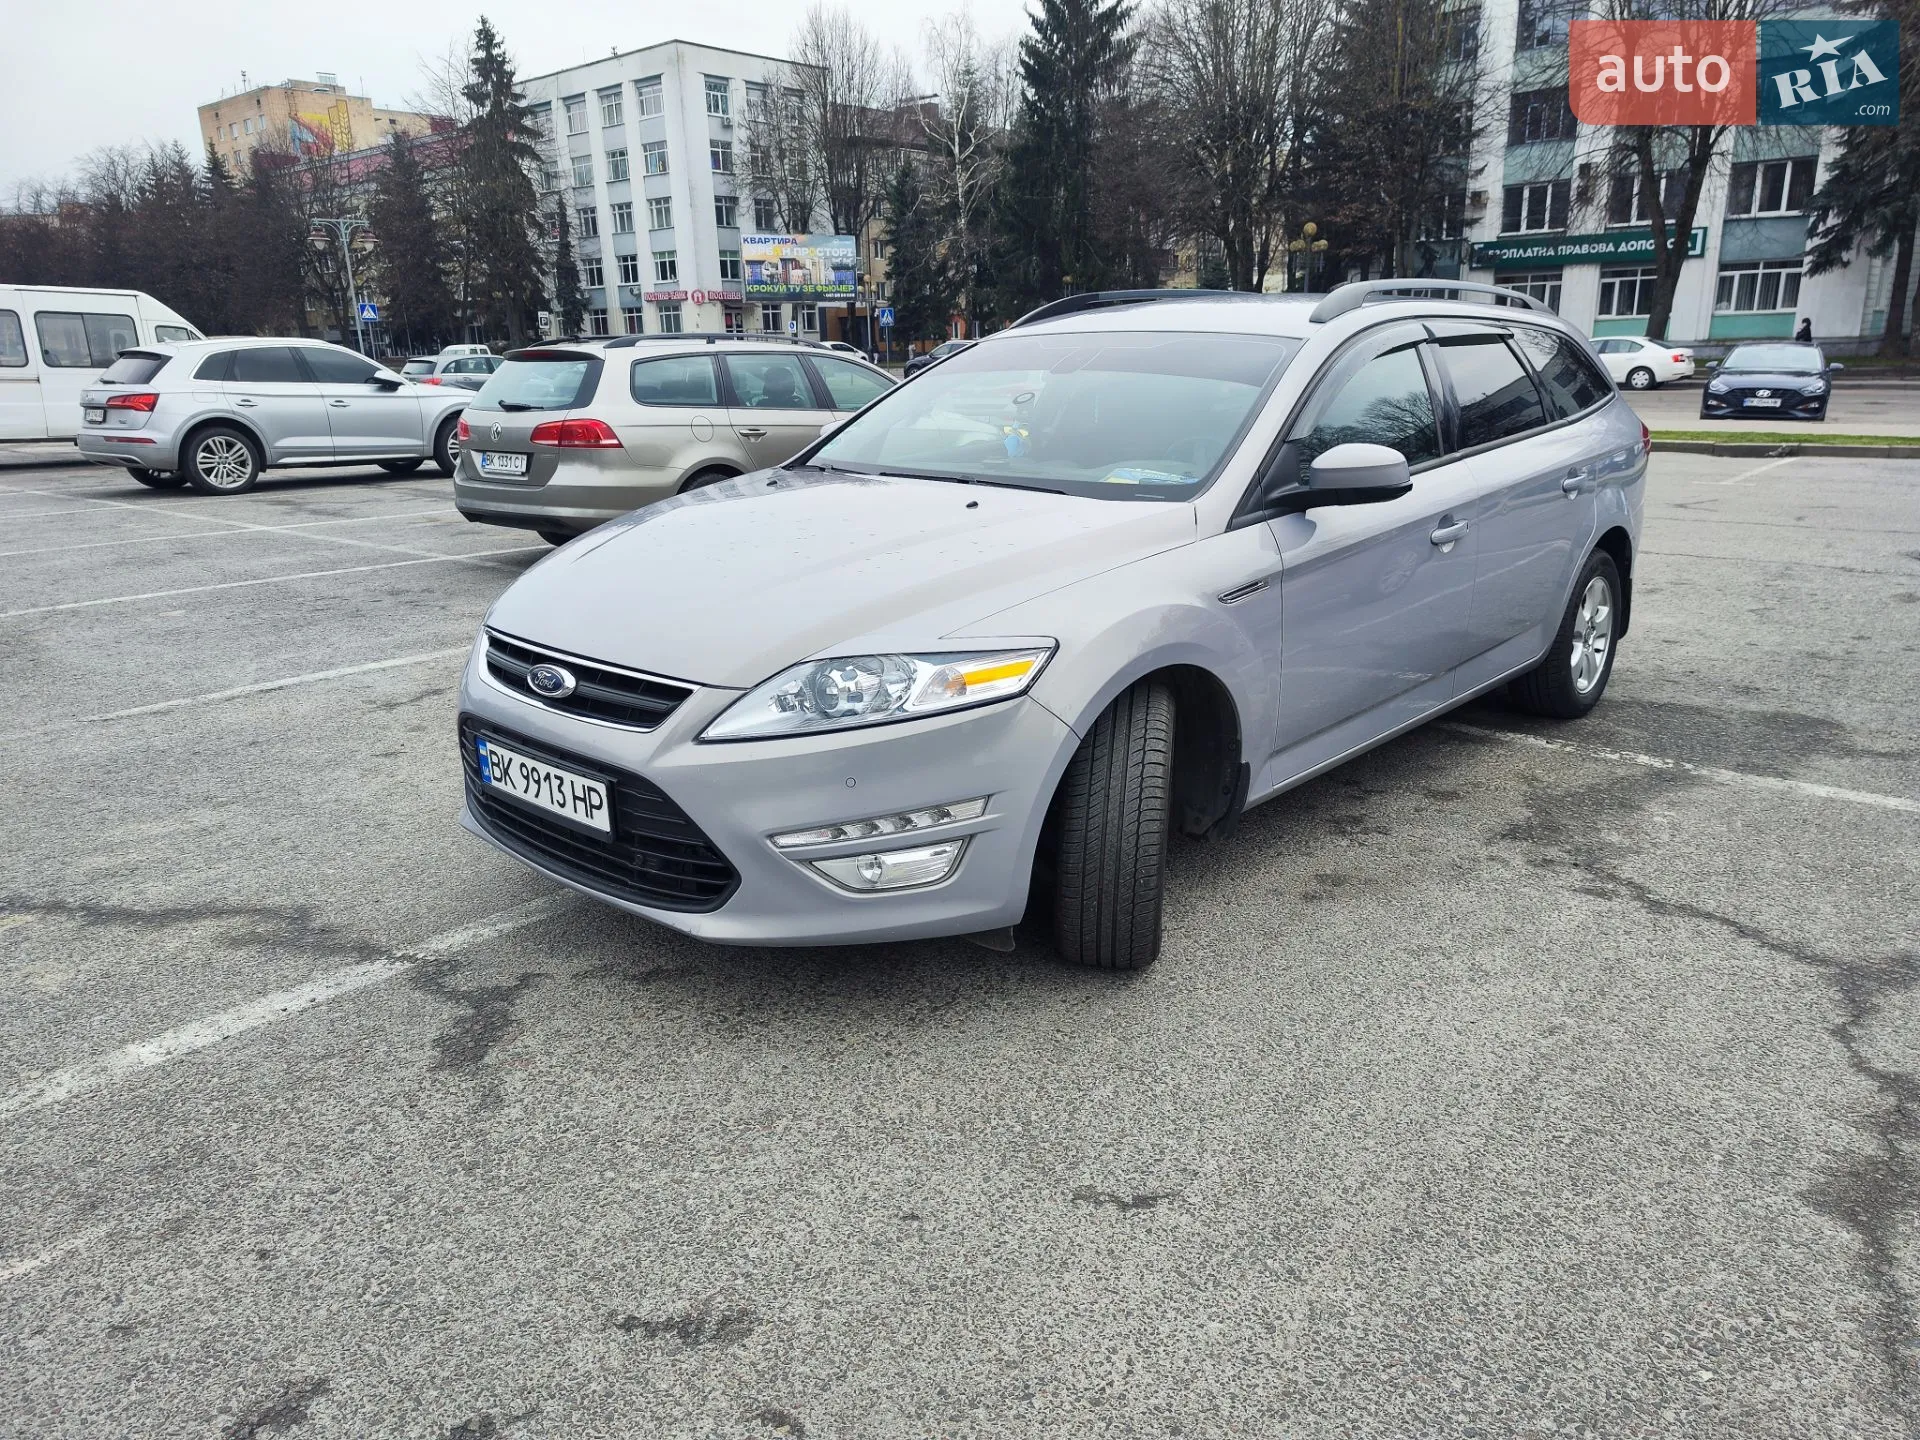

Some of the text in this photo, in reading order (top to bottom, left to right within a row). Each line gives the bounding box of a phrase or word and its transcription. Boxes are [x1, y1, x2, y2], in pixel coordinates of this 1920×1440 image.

[743, 237, 798, 246] КВАРТИРА
[794, 247, 853, 257] ПРОСТОРІ
[1557, 243, 1615, 256] ПРАВОВА
[746, 284, 787, 293] КРОКУЙ
[788, 285, 800, 293] ТУ
[534, 670, 556, 688] Ford
[489, 749, 604, 819] BK 9913 HP
